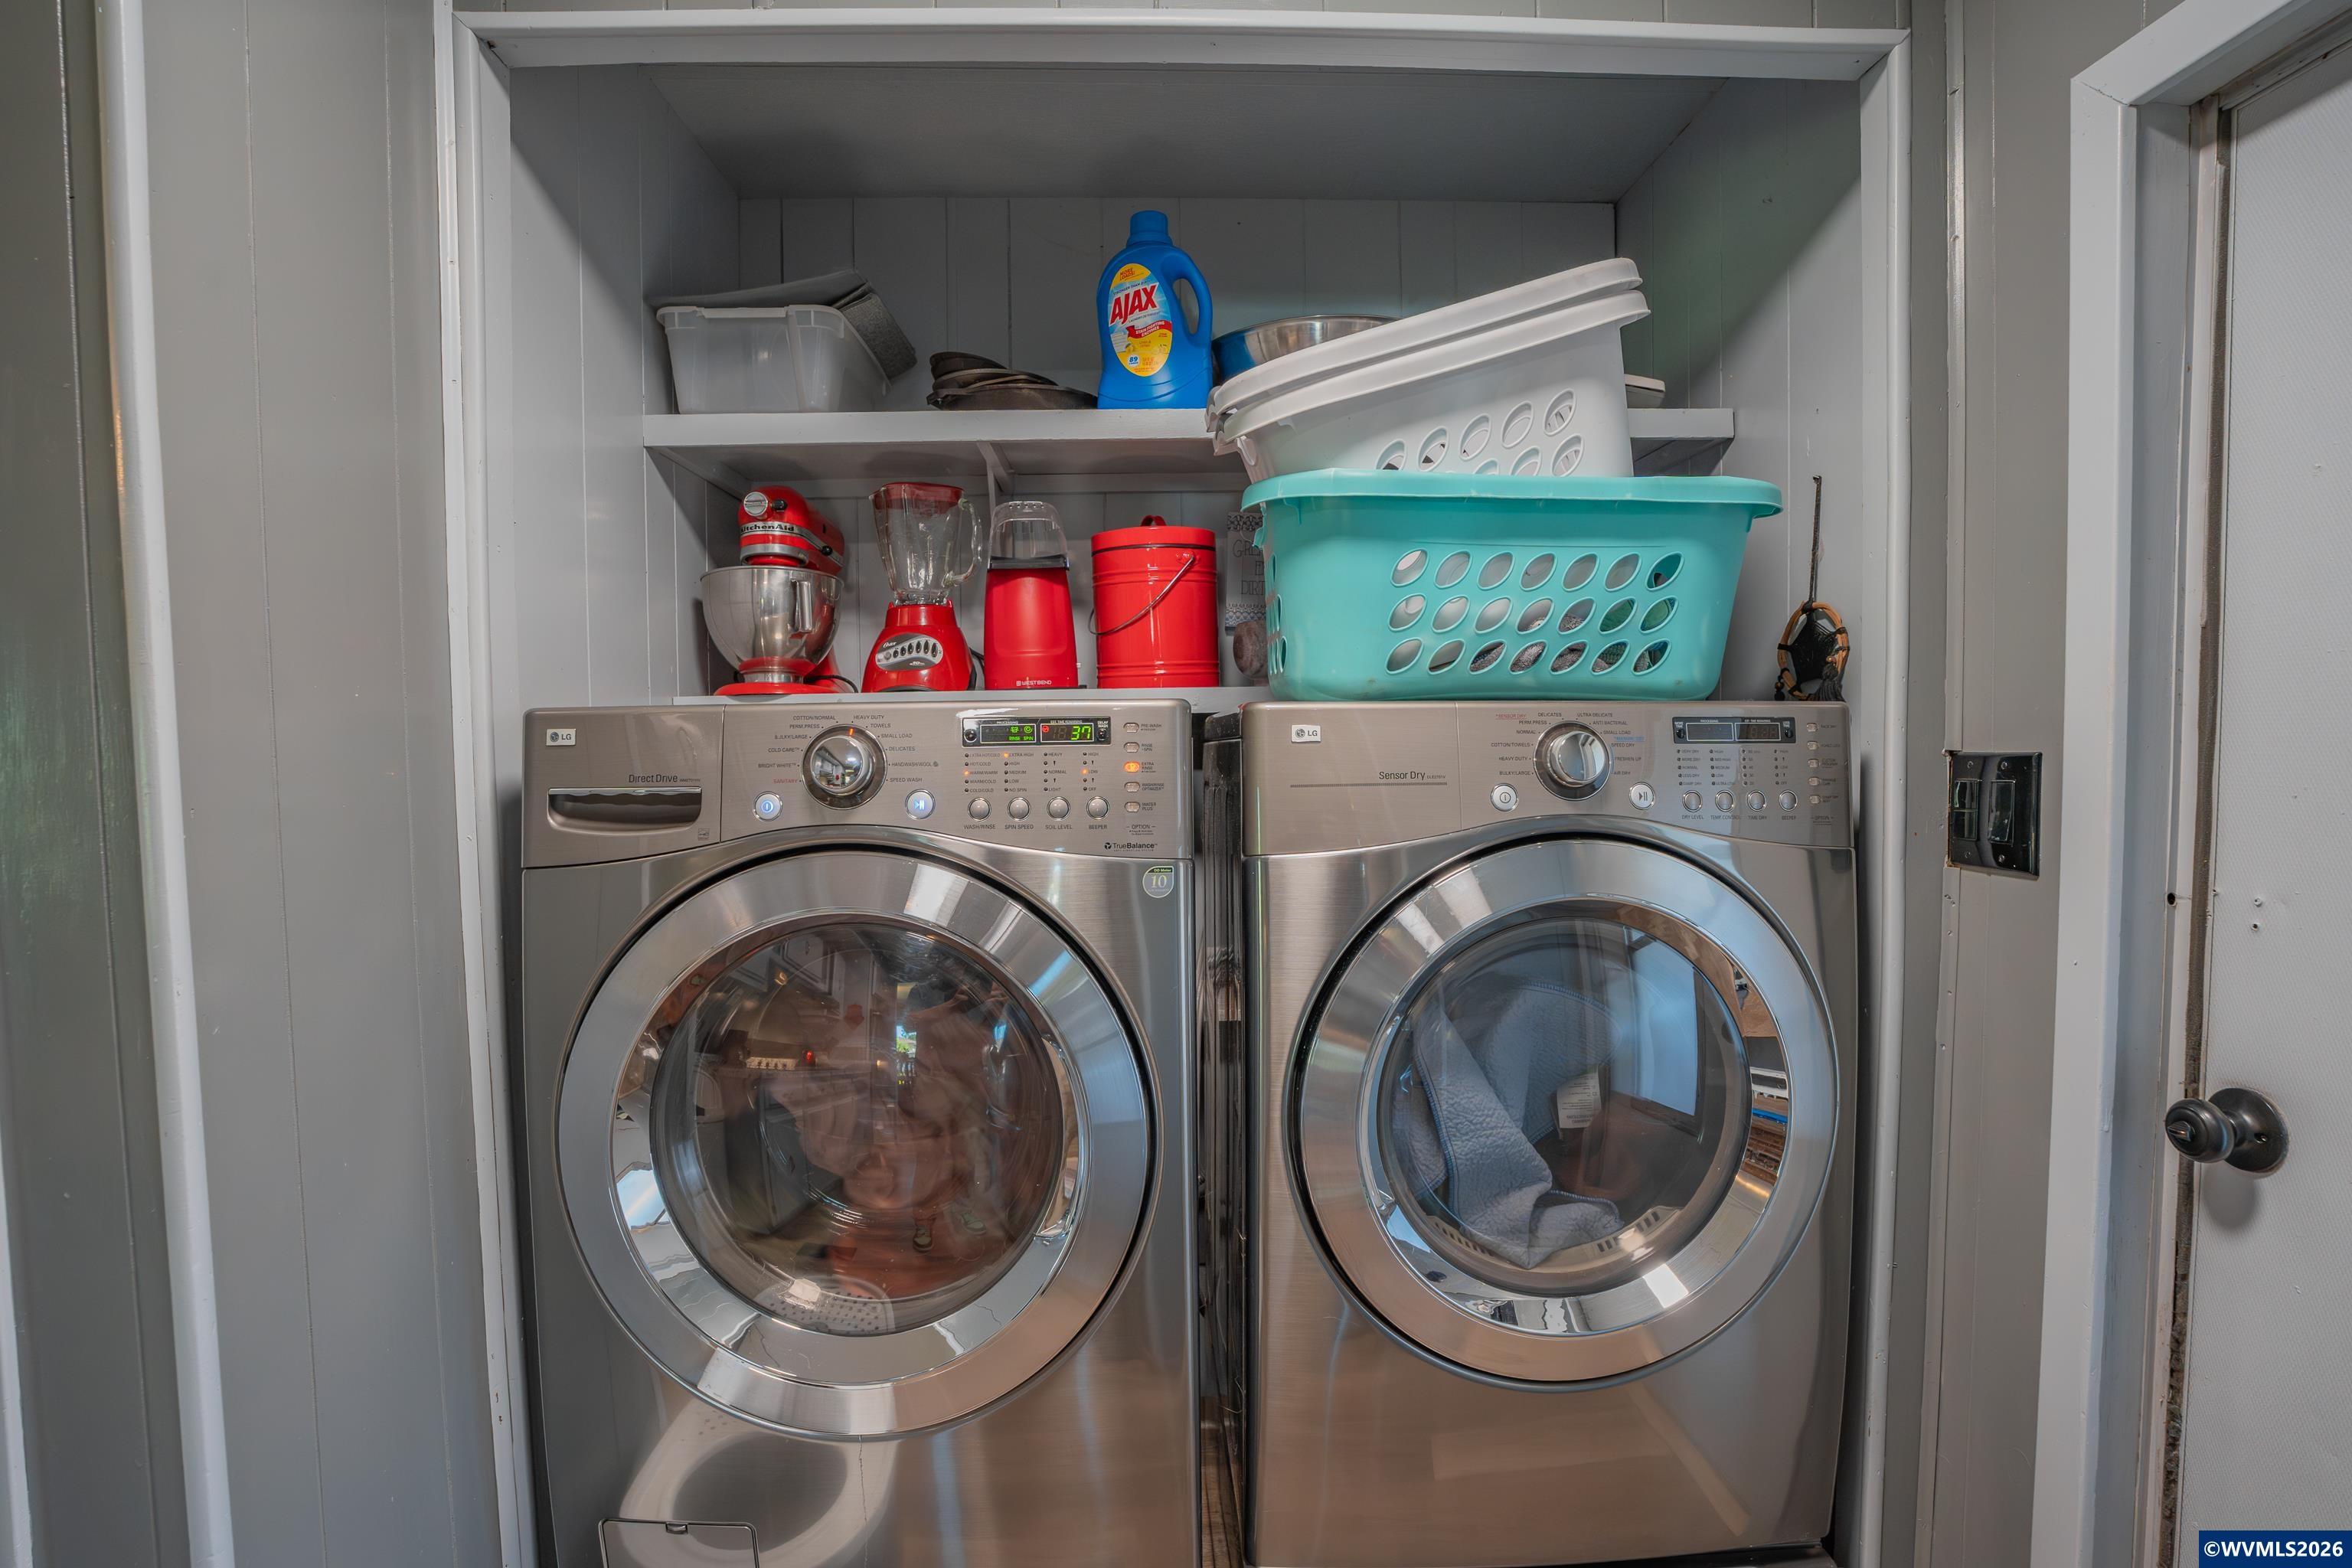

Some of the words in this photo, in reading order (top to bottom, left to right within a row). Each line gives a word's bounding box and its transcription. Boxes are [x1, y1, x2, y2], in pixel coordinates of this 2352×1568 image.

[1110, 285, 1157, 325] AJAX
[1142, 325, 1159, 337] ENZYMES
[1147, 321, 1165, 331] FIGHTING
[1071, 726, 1091, 740] 37
[629, 775, 654, 783] Direct
[656, 774, 678, 782] Drive
[1379, 771, 1408, 779] Sensor
[1410, 771, 1426, 781] Dry
[1152, 874, 1167, 888] 10
